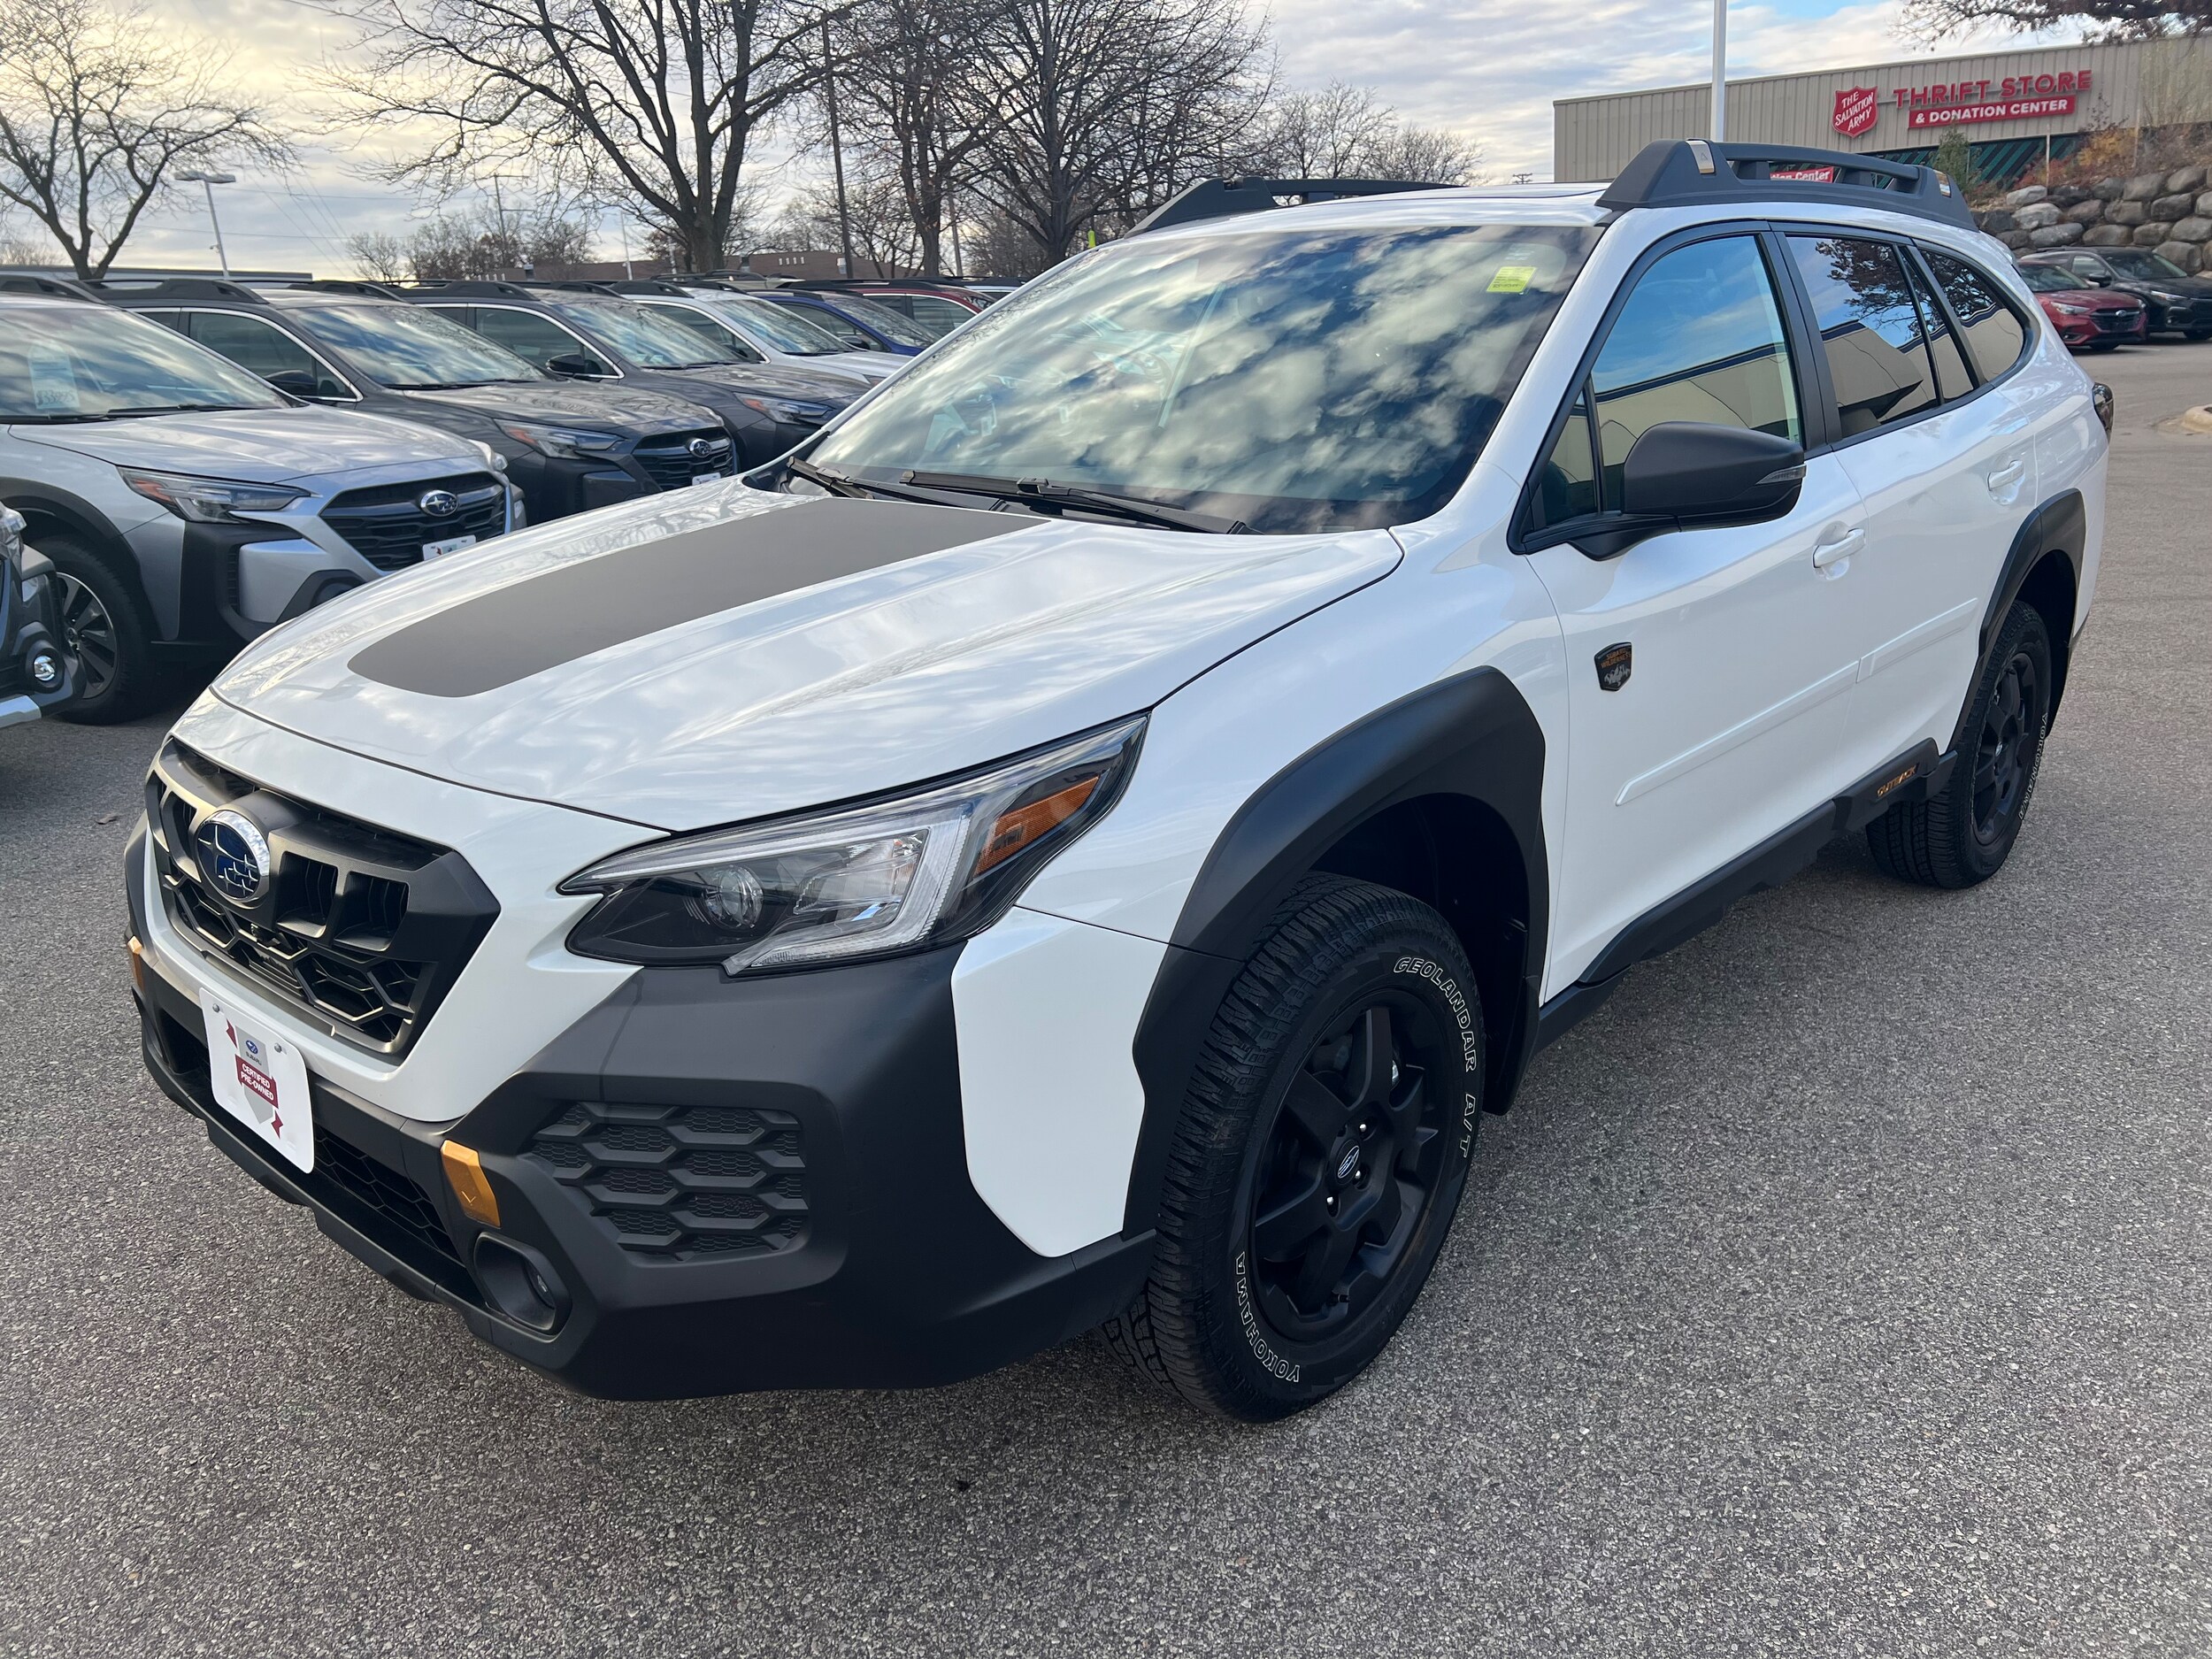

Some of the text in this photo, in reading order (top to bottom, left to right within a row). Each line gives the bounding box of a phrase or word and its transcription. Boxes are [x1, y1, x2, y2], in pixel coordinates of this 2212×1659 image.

[1841, 91, 1859, 108] THE
[1893, 70, 2093, 108] THRIFT STORE
[1835, 92, 1874, 126] SALVATION
[1847, 106, 1871, 131] ARMY
[1916, 99, 2068, 124] & DONATION CENTER
[1794, 170, 1831, 180] Center
[2018, 712, 2048, 820] YOKOHAMA
[1393, 956, 1477, 1158] GEOLANDAR A/T
[241, 1071, 274, 1101] PRE-OWNED
[242, 1063, 271, 1088] CERTIFIED
[1235, 1251, 1300, 1383] YOKOHAMA
